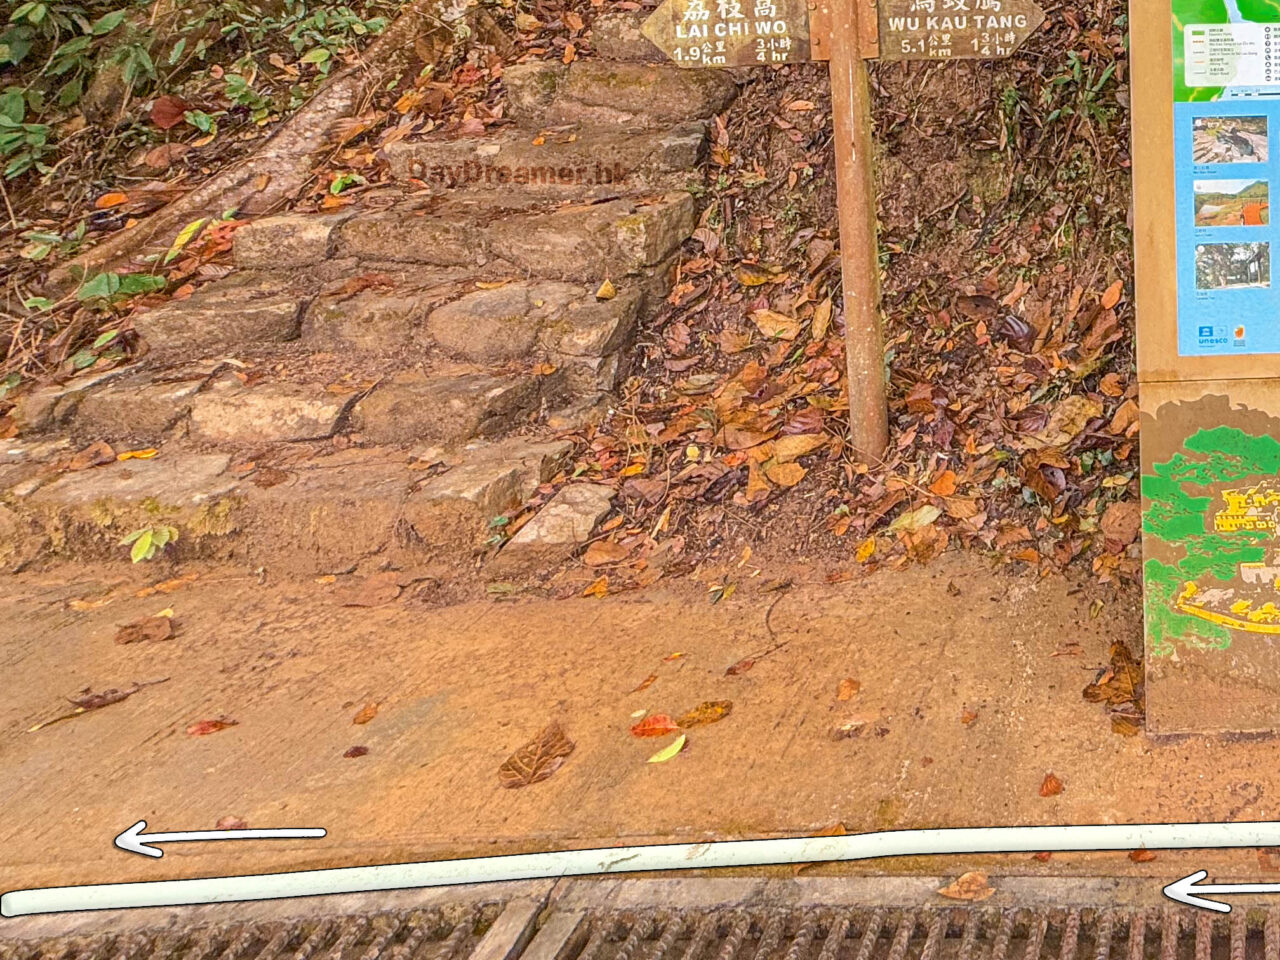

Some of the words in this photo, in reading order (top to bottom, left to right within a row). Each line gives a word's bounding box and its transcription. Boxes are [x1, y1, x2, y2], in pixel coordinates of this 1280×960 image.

[676, 24, 708, 38] LAI
[714, 22, 749, 37] CHI
[755, 21, 787, 35] WO
[889, 17, 919, 31] WU
[926, 16, 967, 30] KAU
[973, 15, 1027, 29] TANG
[767, 36, 792, 50] 小時
[901, 39, 925, 53] 5.1
[928, 33, 952, 46] 公里
[992, 31, 1016, 45] 小時
[673, 46, 700, 61] 1.9
[701, 41, 726, 53] 公里
[772, 50, 788, 61] hr
[929, 48, 952, 57] km
[996, 46, 1012, 56] hr
[702, 54, 726, 65] km
